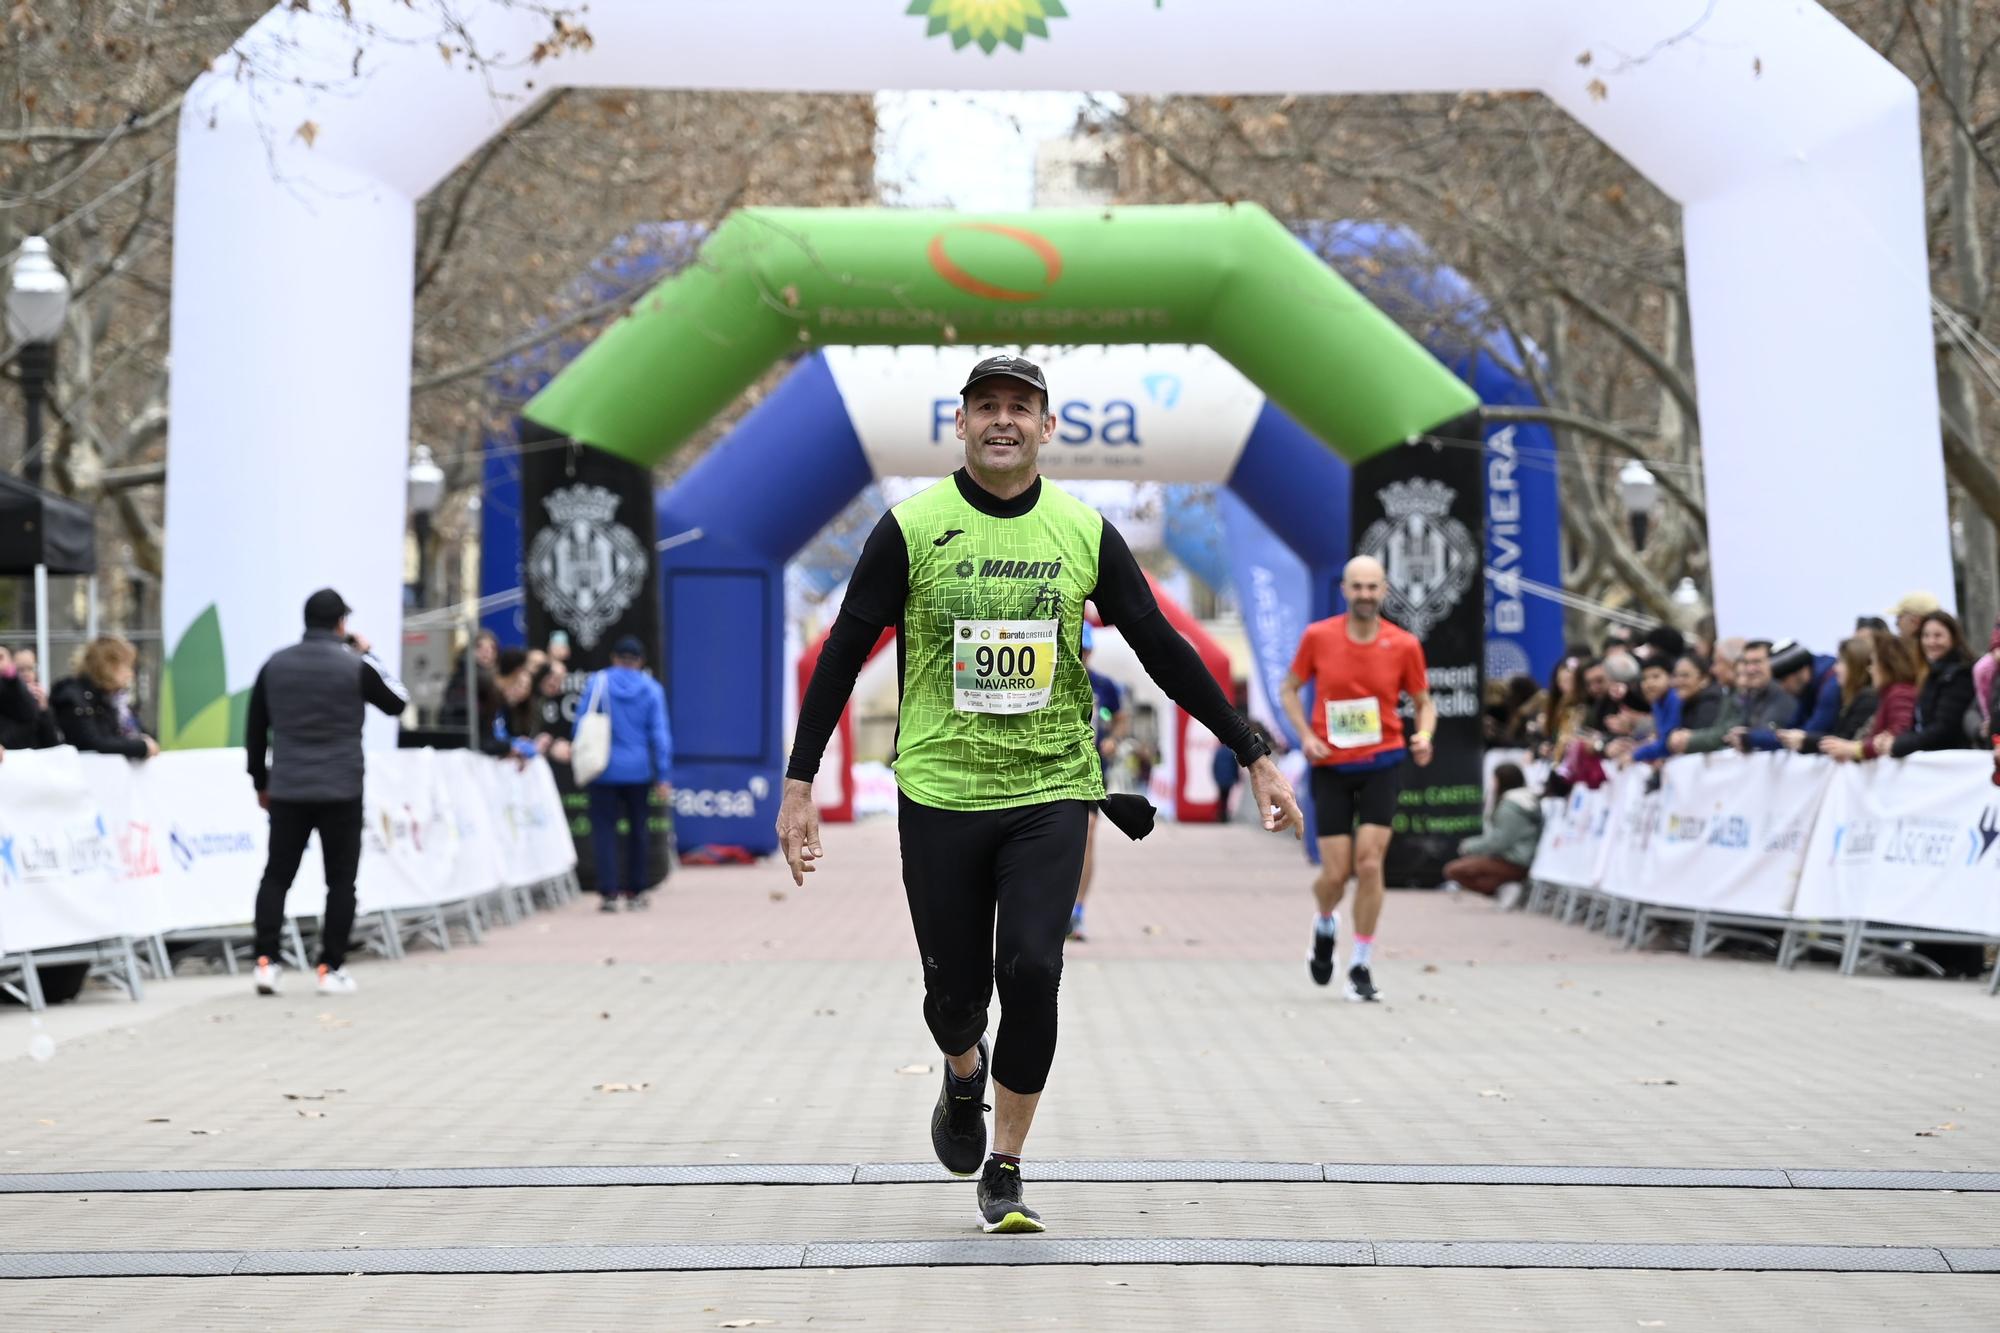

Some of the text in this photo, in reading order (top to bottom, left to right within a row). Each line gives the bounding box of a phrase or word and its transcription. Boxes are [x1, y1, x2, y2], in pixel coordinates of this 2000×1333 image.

[930, 398, 1142, 446] Fsa
[1487, 424, 1524, 634] BAVIERA
[979, 556, 1062, 579] MARATÓ
[999, 630, 1053, 640] marató CASTELLÓ
[975, 646, 1036, 677] 900
[975, 678, 1035, 689] NAVARRO
